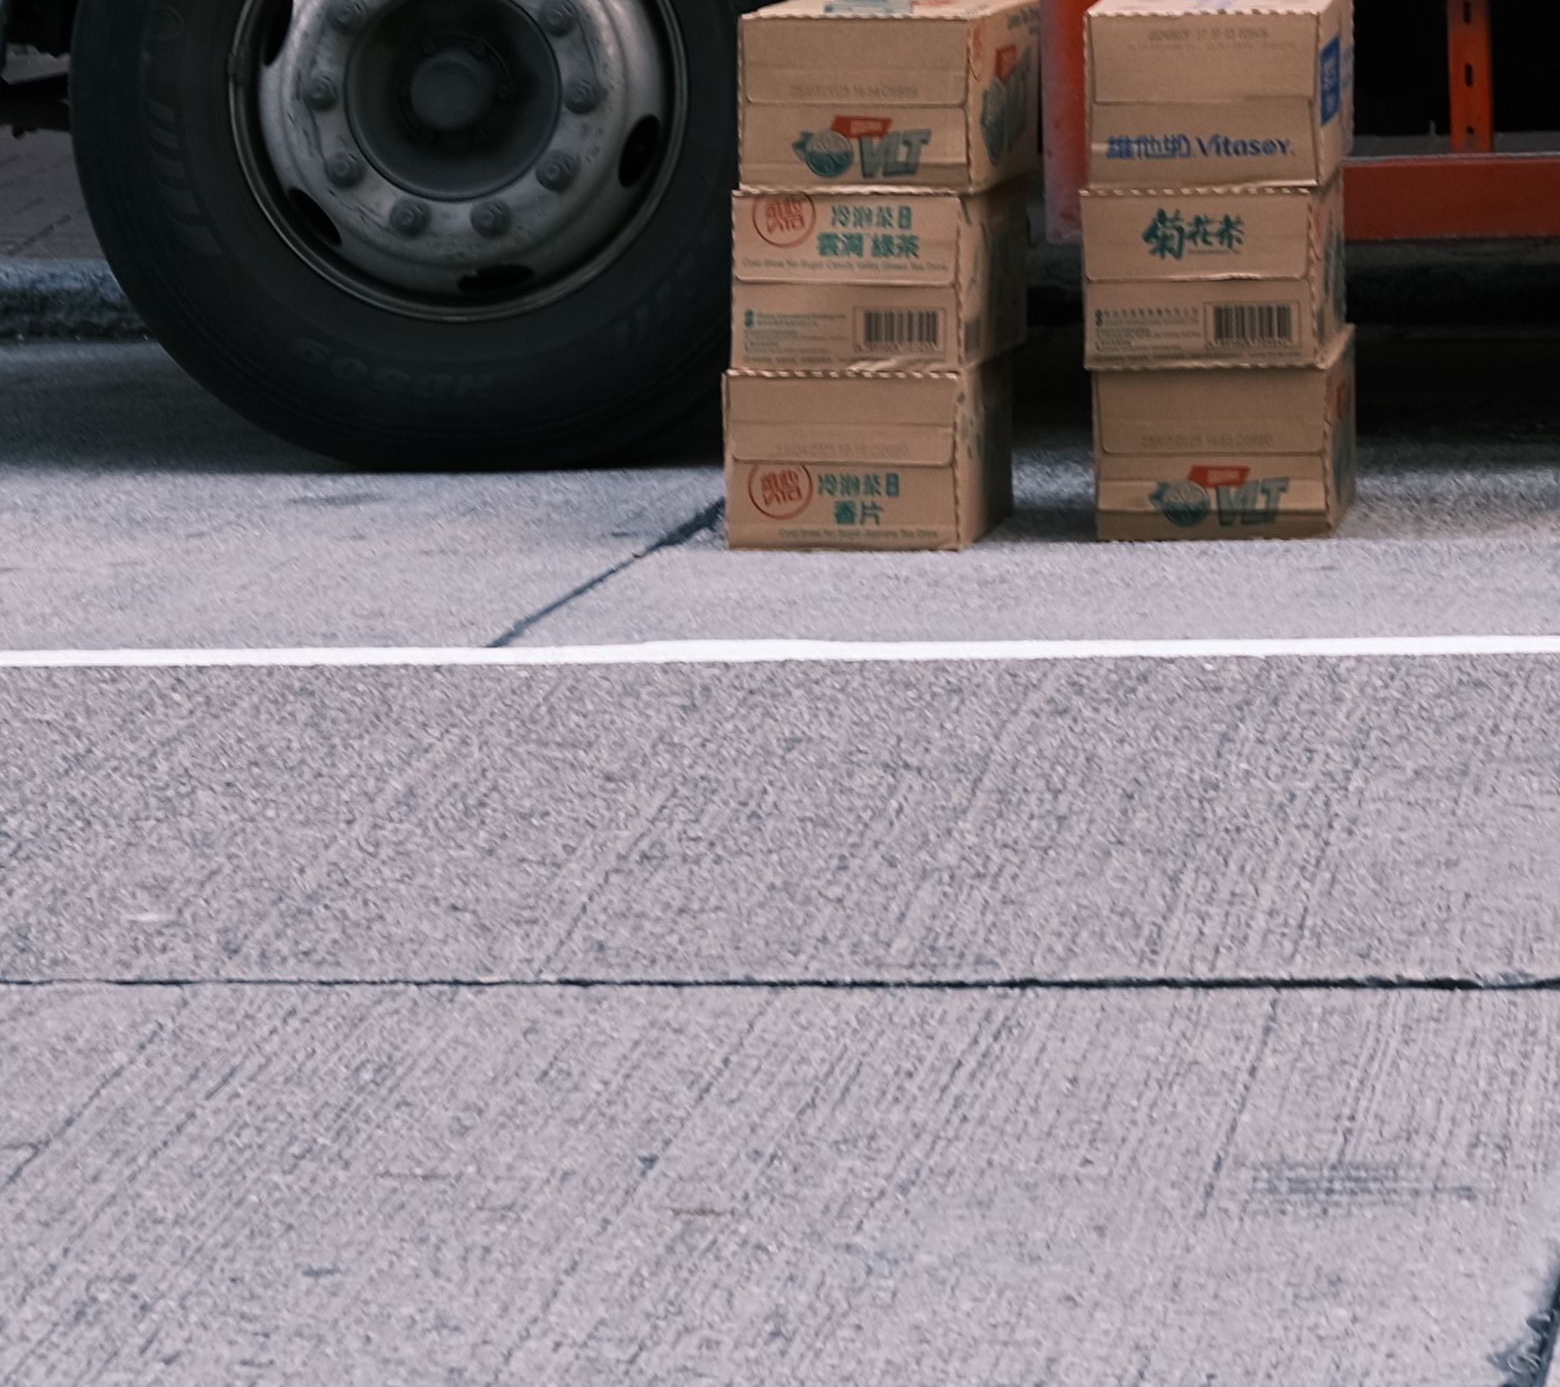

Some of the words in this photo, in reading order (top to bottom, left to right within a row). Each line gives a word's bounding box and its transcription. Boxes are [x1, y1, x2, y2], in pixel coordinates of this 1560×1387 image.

[858, 128, 933, 179] VLT
[1106, 134, 1192, 160] 維他奶
[1196, 133, 1289, 157] Vitasoy
[1142, 207, 1245, 261] 菊花茶
[834, 500, 884, 526] 香片
[1214, 475, 1290, 526] VLT
